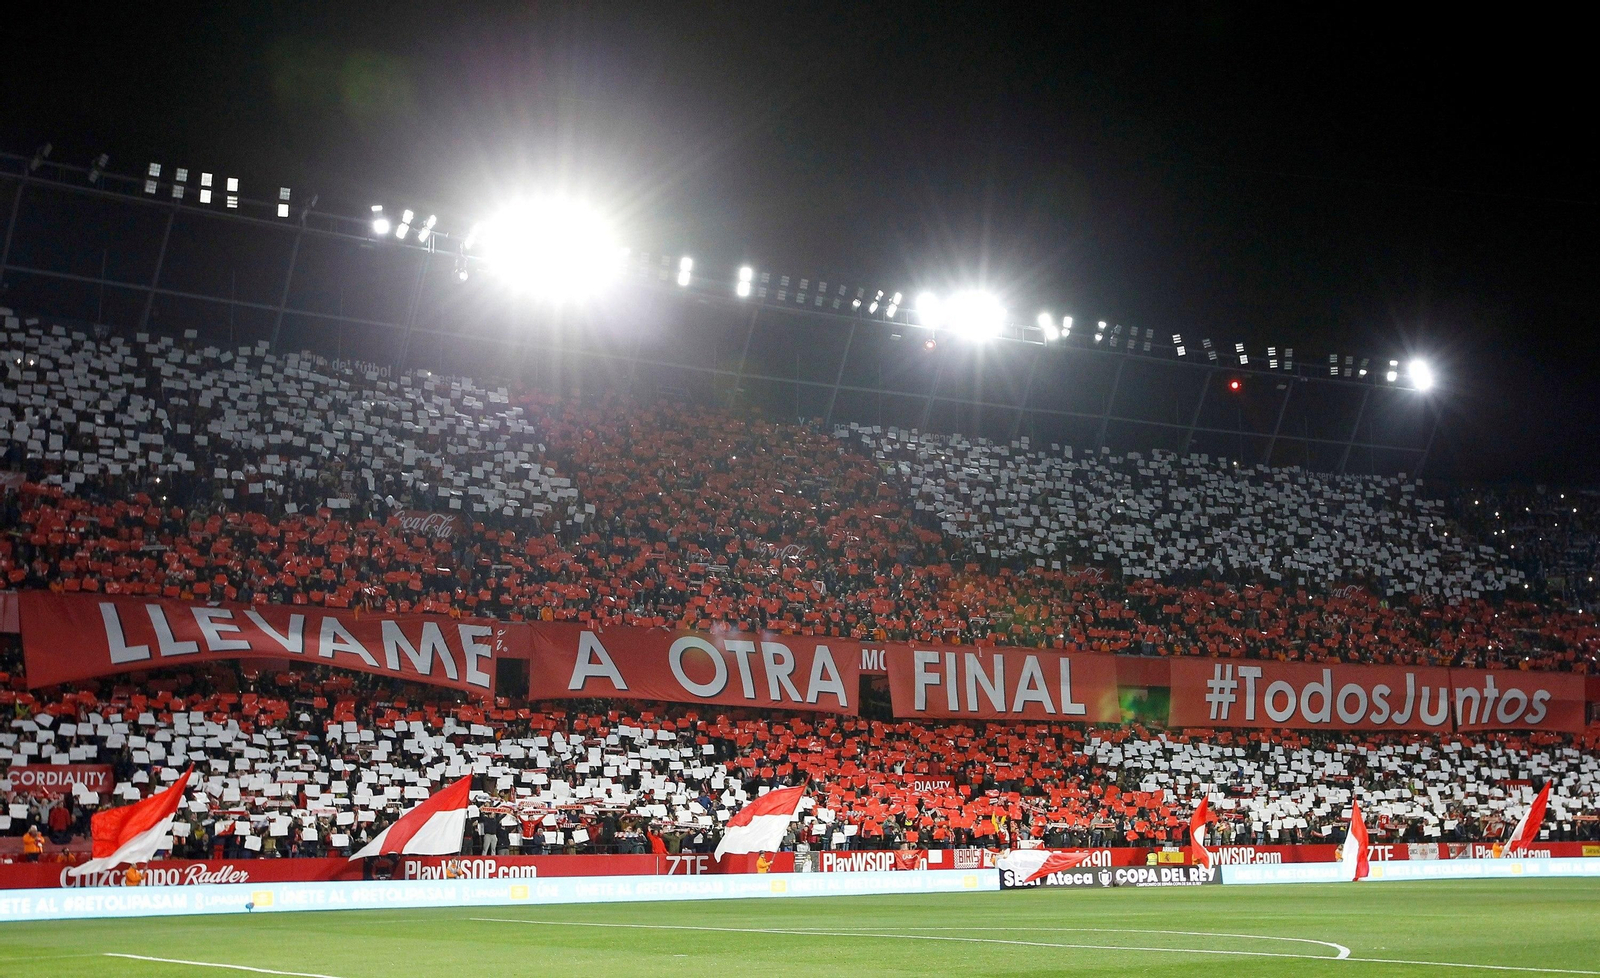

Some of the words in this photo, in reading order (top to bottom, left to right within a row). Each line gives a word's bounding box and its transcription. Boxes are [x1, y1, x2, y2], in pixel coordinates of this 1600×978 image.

[99, 602, 493, 688] LLEVAME
[568, 631, 628, 690] A
[668, 636, 848, 707] OTRA
[914, 650, 1086, 715] FINAL
[1205, 663, 1551, 726] #TodosJuntos
[7, 770, 106, 786] CORDIALITY
[823, 851, 927, 872] PlayWSOP.m
[184, 863, 249, 885] Radler
[1004, 871, 1041, 887] SE
[1046, 871, 1093, 885] Ateca
[1116, 868, 1157, 883] COPA
[1161, 868, 1187, 882] DEL
[1188, 868, 1215, 882] REY
